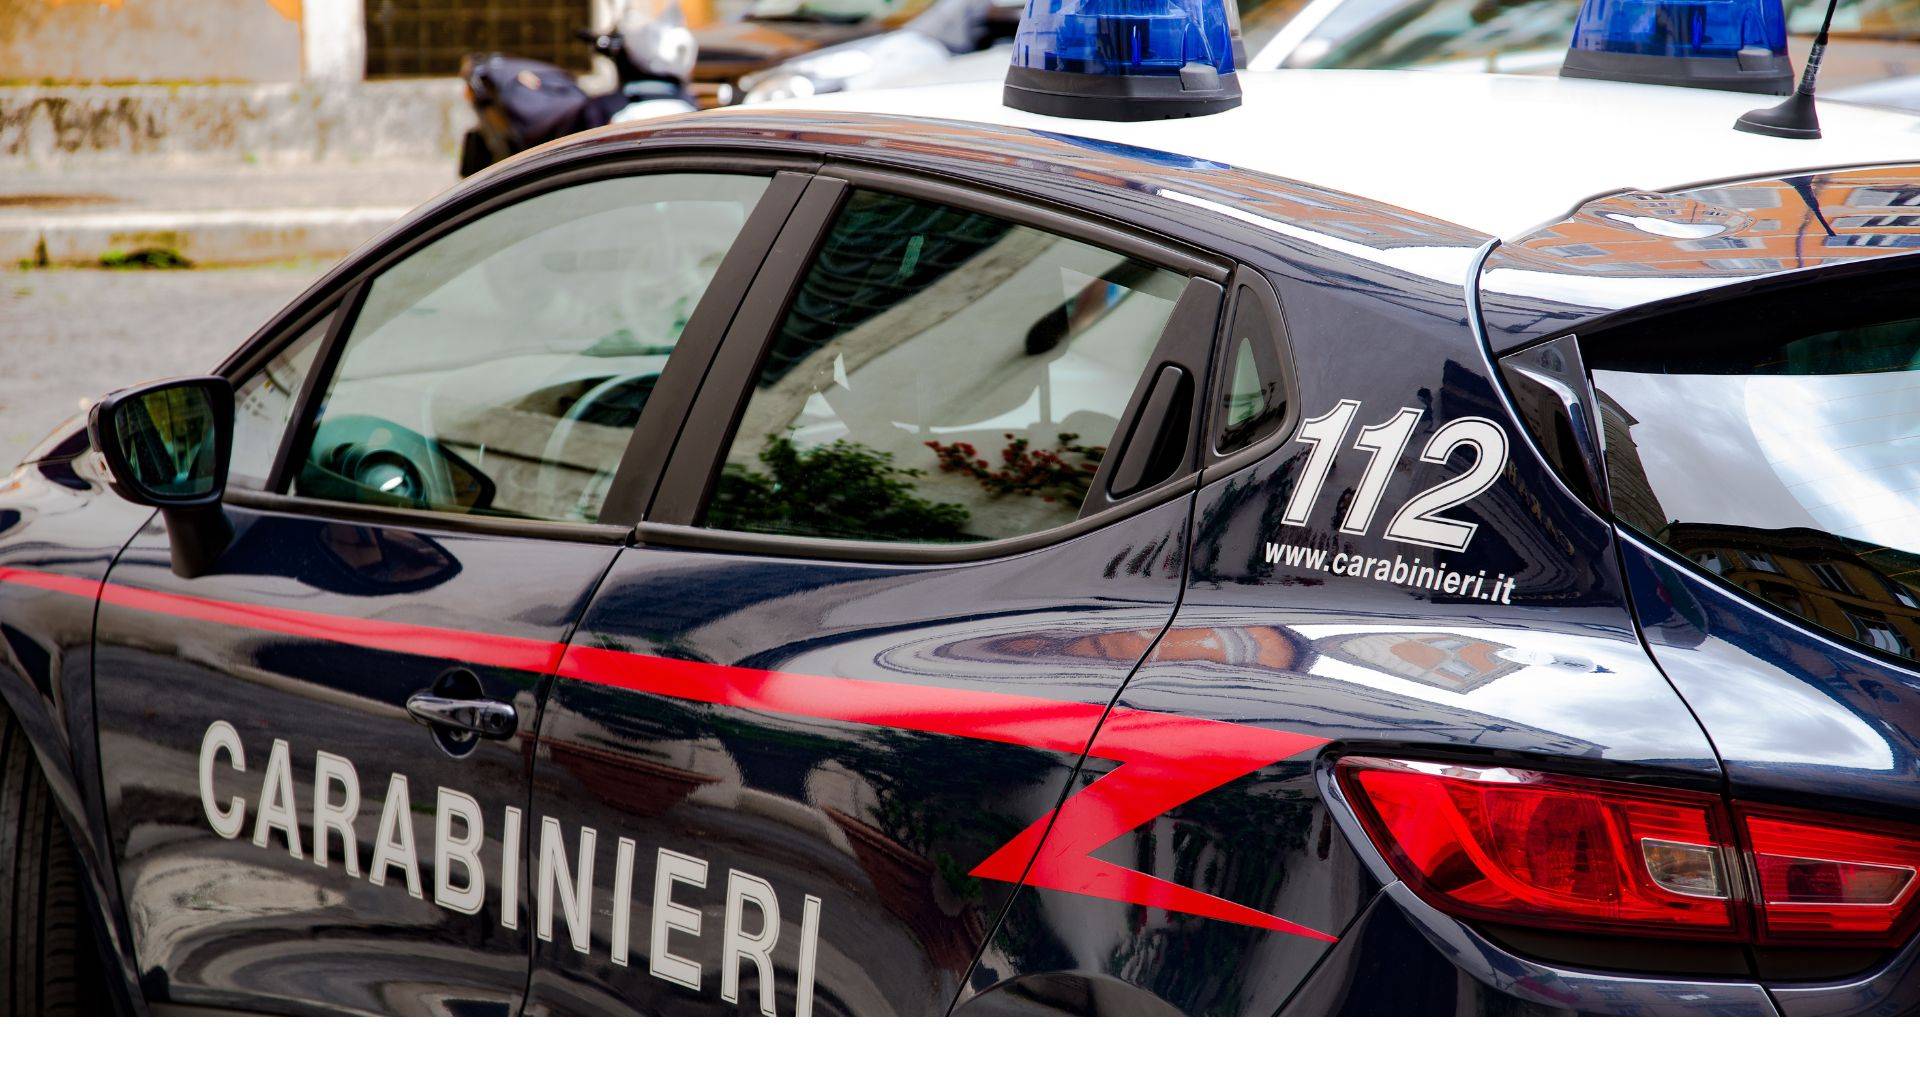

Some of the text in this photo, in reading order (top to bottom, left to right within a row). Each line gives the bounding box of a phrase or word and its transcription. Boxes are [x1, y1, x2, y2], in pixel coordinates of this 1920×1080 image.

[1281, 399, 1509, 553] 112
[1265, 541, 1516, 604] www.carabinieri.it
[200, 720, 821, 1017] CARABINIERI
